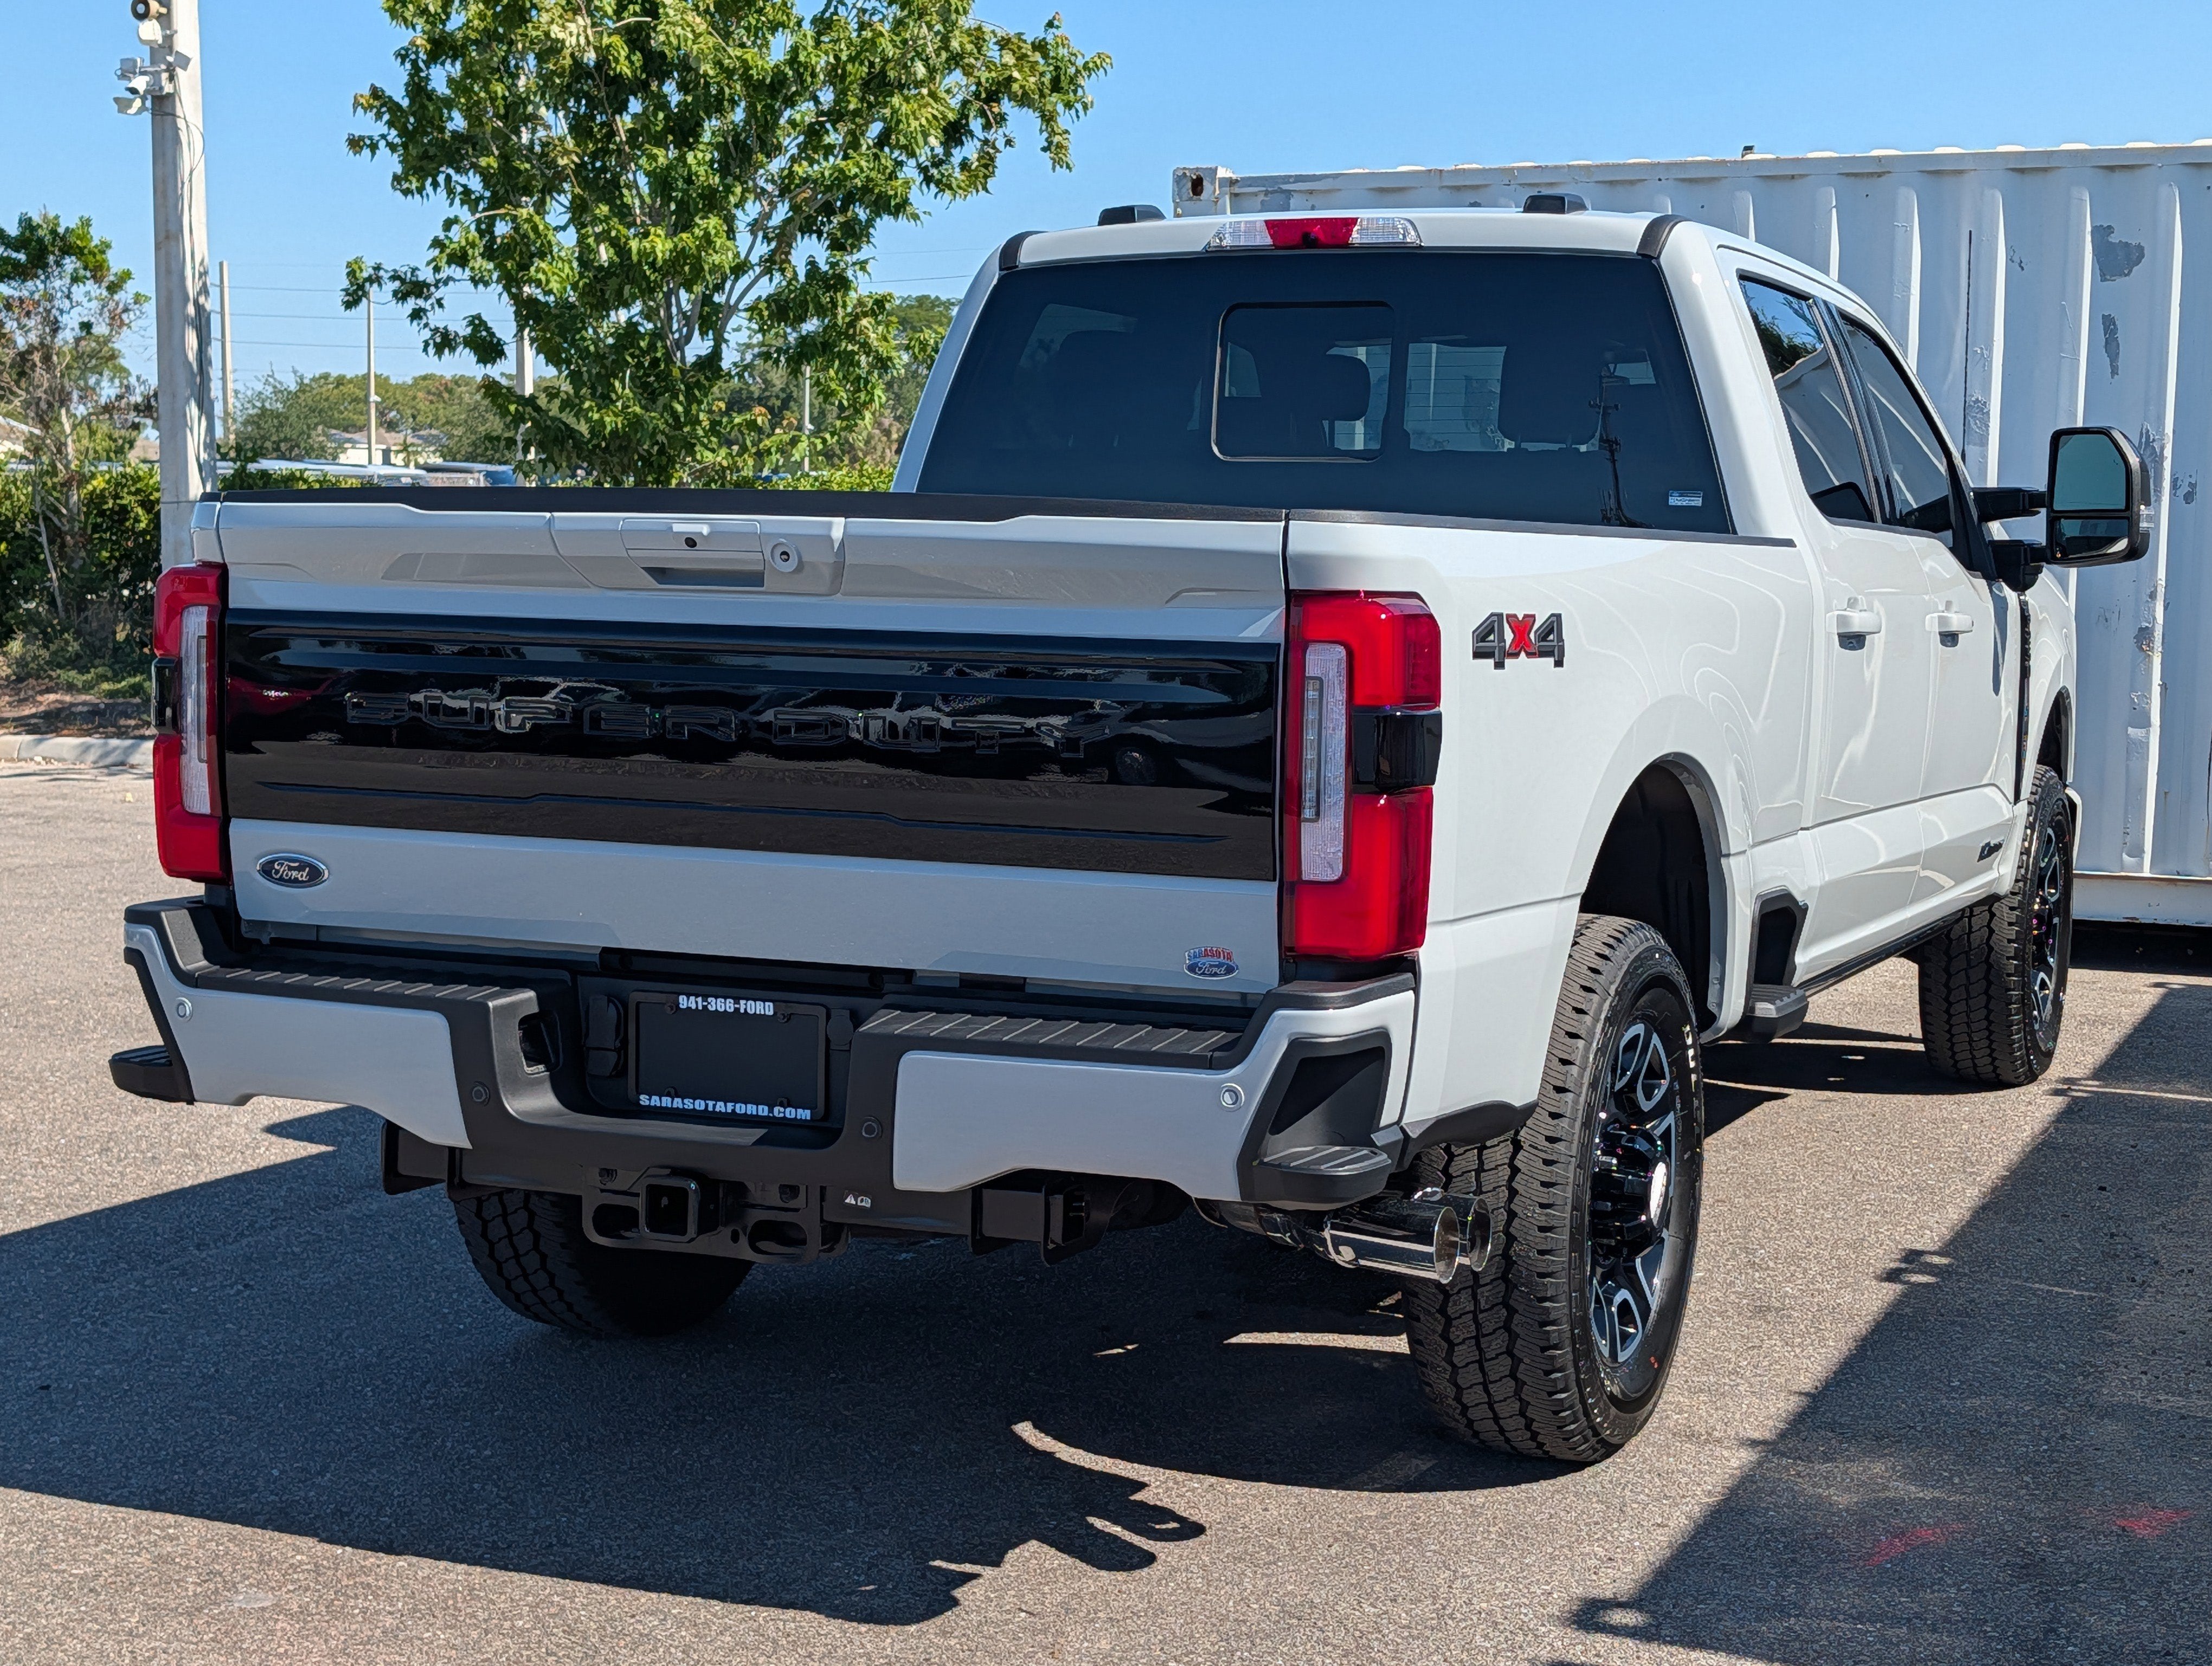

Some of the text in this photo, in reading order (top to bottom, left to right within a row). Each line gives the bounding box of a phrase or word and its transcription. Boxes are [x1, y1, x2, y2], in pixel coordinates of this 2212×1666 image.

[346, 691, 1110, 758] SUPER DUTY
[272, 860, 310, 881] Ford
[1195, 961, 1227, 975] Ford
[678, 995, 774, 1016] 941-366-FORD
[639, 1094, 811, 1120] SARASOTAFORD.COM
